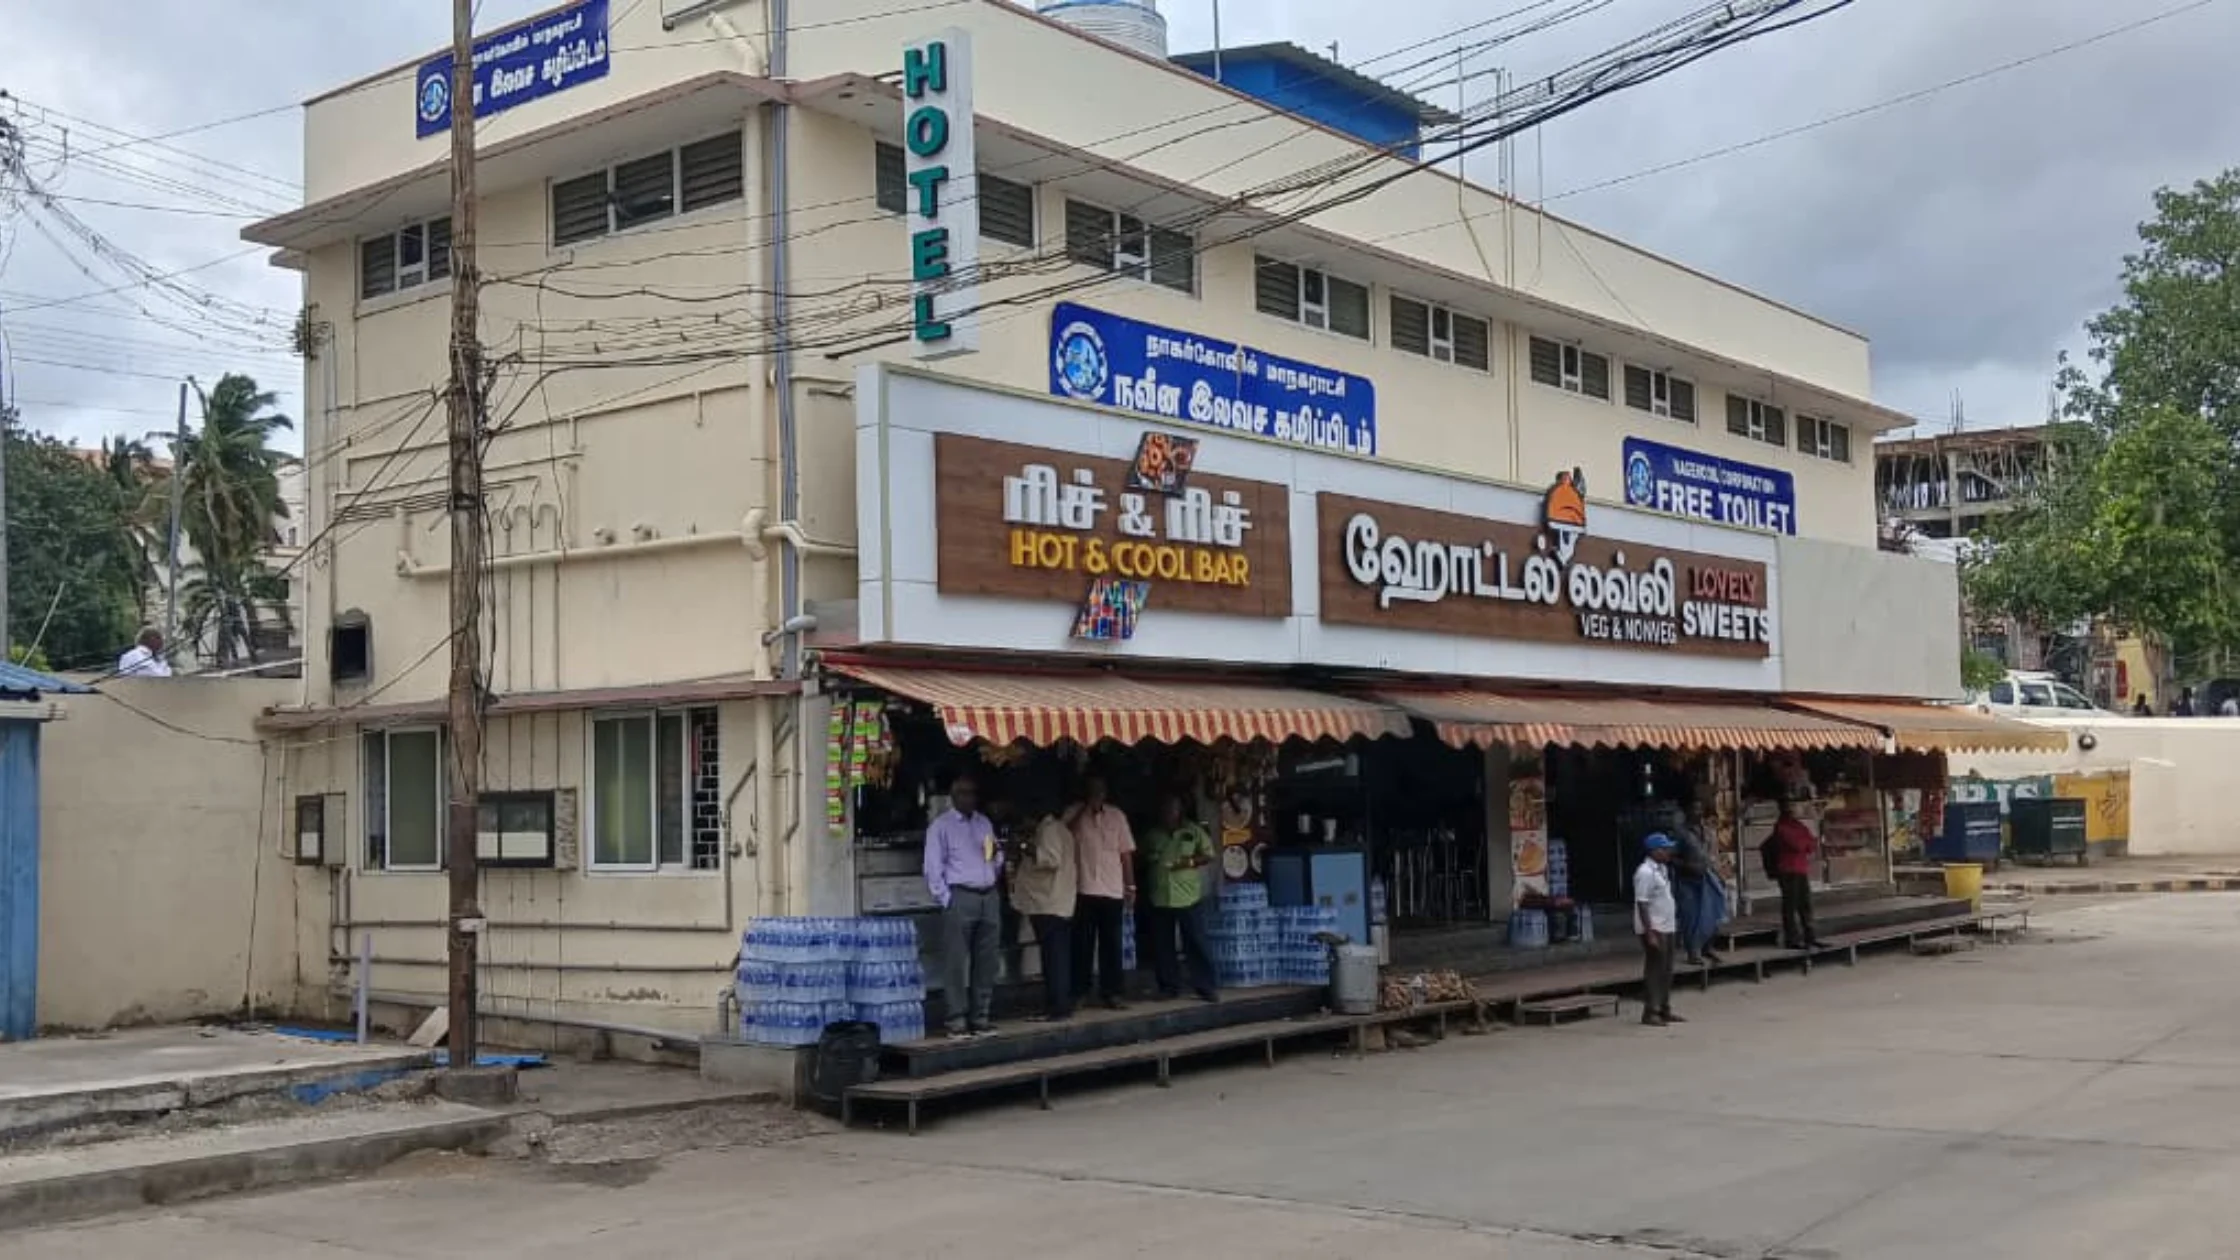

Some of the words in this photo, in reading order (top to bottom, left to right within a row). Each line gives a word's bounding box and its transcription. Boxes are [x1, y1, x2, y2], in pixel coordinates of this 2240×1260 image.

[490, 65, 535, 98] இலவச
[904, 41, 950, 341] HOTEL
[1114, 366, 1182, 418] நவீன
[1188, 380, 1269, 433] இலவச
[1003, 464, 1107, 530] ரிச்
[1117, 493, 1156, 537] &
[1166, 486, 1253, 547] ரிச்
[1656, 479, 1713, 520] FREE
[1718, 492, 1790, 537] TOILET
[1011, 529, 1079, 570] HOT
[1084, 538, 1109, 574] &
[1112, 541, 1191, 581] COOL
[1199, 549, 1250, 586] BAR
[1346, 512, 1560, 609] ஹோட்டல்
[1568, 551, 1676, 618] லவ்லி
[1692, 566, 1759, 602] LOVELY
[1580, 612, 1609, 638] VEG
[1611, 615, 1623, 641] &
[1625, 618, 1678, 645] NONVEG
[1682, 600, 1770, 643] SWEETS
